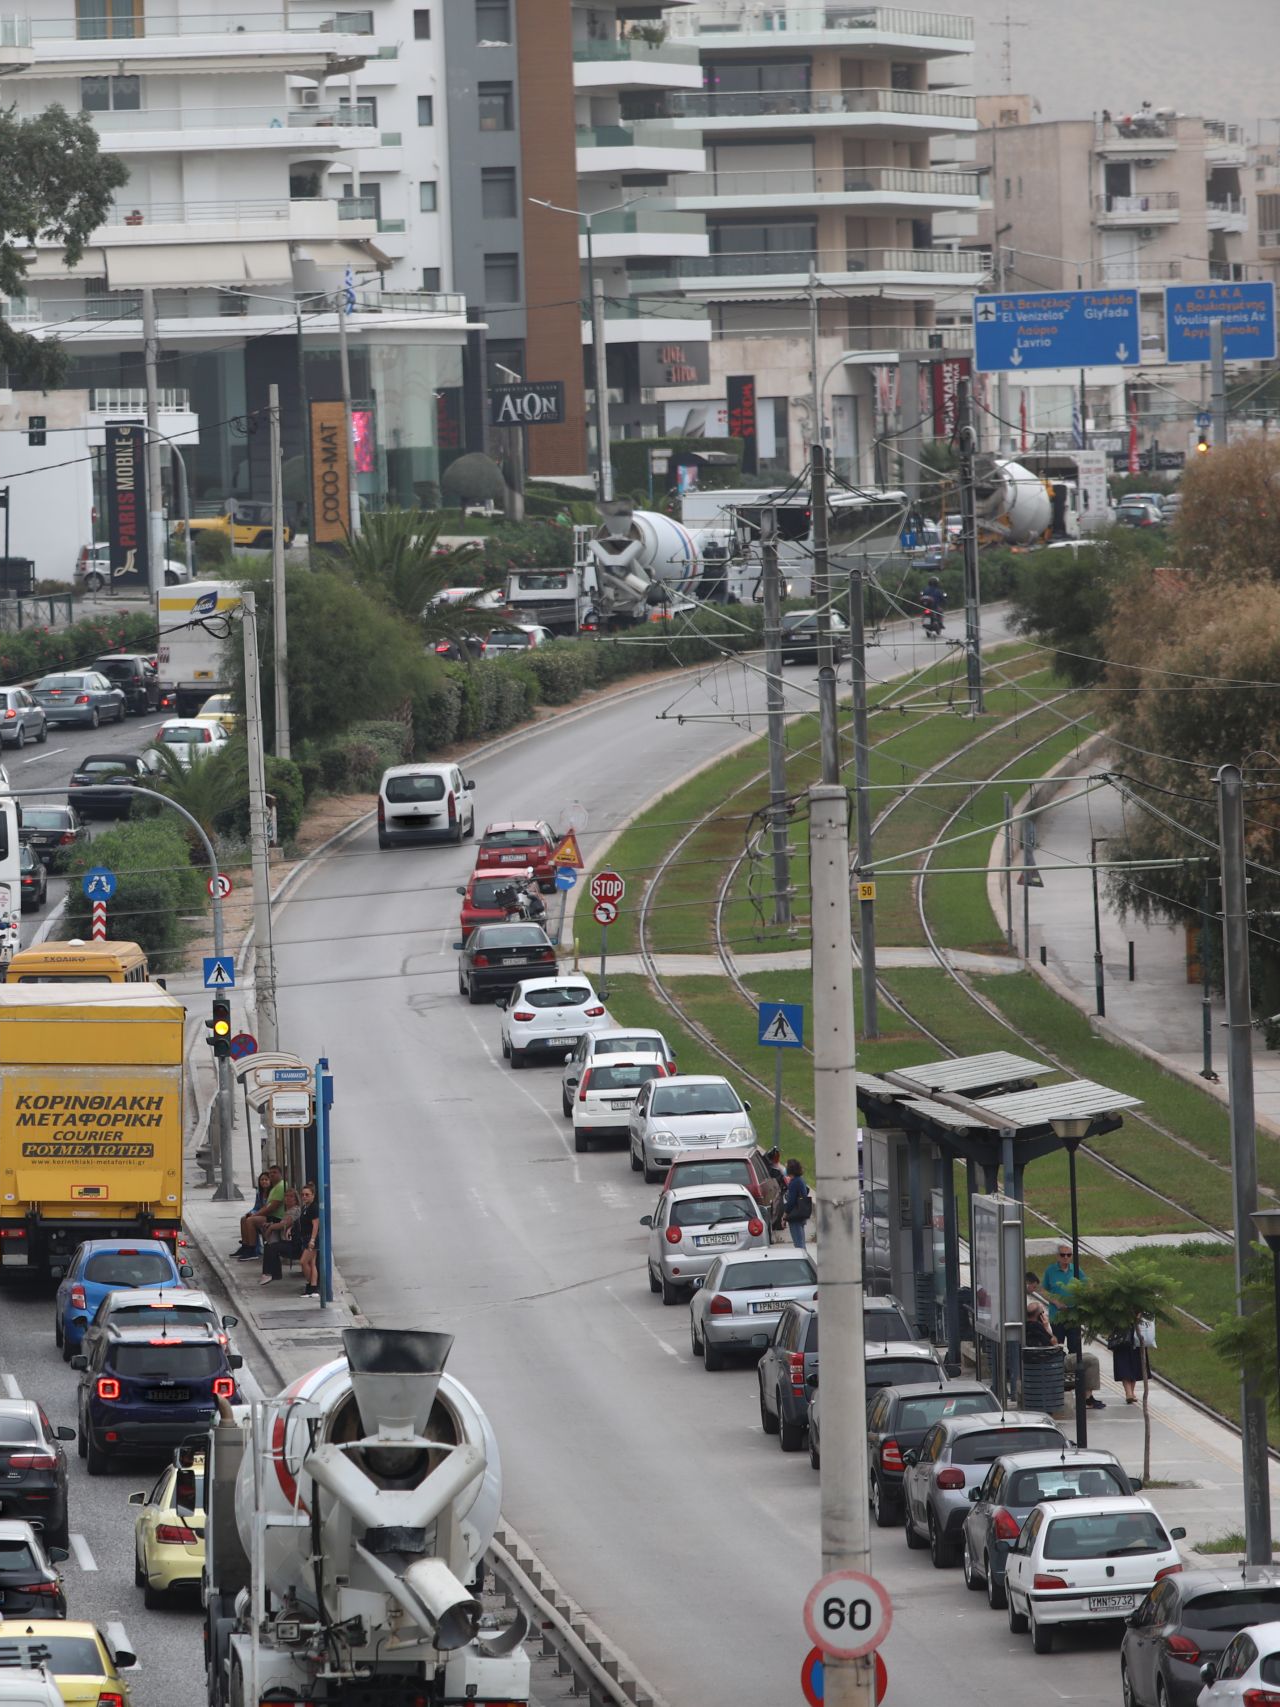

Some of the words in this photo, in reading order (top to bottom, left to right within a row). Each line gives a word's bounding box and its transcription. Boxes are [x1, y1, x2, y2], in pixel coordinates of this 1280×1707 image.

[1084, 307, 1129, 320] Glyfada
[1017, 338, 1052, 348] Lavrio
[321, 422, 340, 524] COCO-MAT
[118, 493, 136, 547] PARIS
[593, 880, 622, 897] STOP
[16, 1095, 164, 1110] ΚΟΡΙΝΘΙΑΚΗ
[16, 1113, 163, 1127] ΜΕΤΑΦΟΡΙΚΗ
[53, 1131, 124, 1141] COURIER
[24, 1145, 153, 1156] ΡΟΥΜΕΛΙΩΤΗΣ
[823, 1597, 871, 1631] 60
